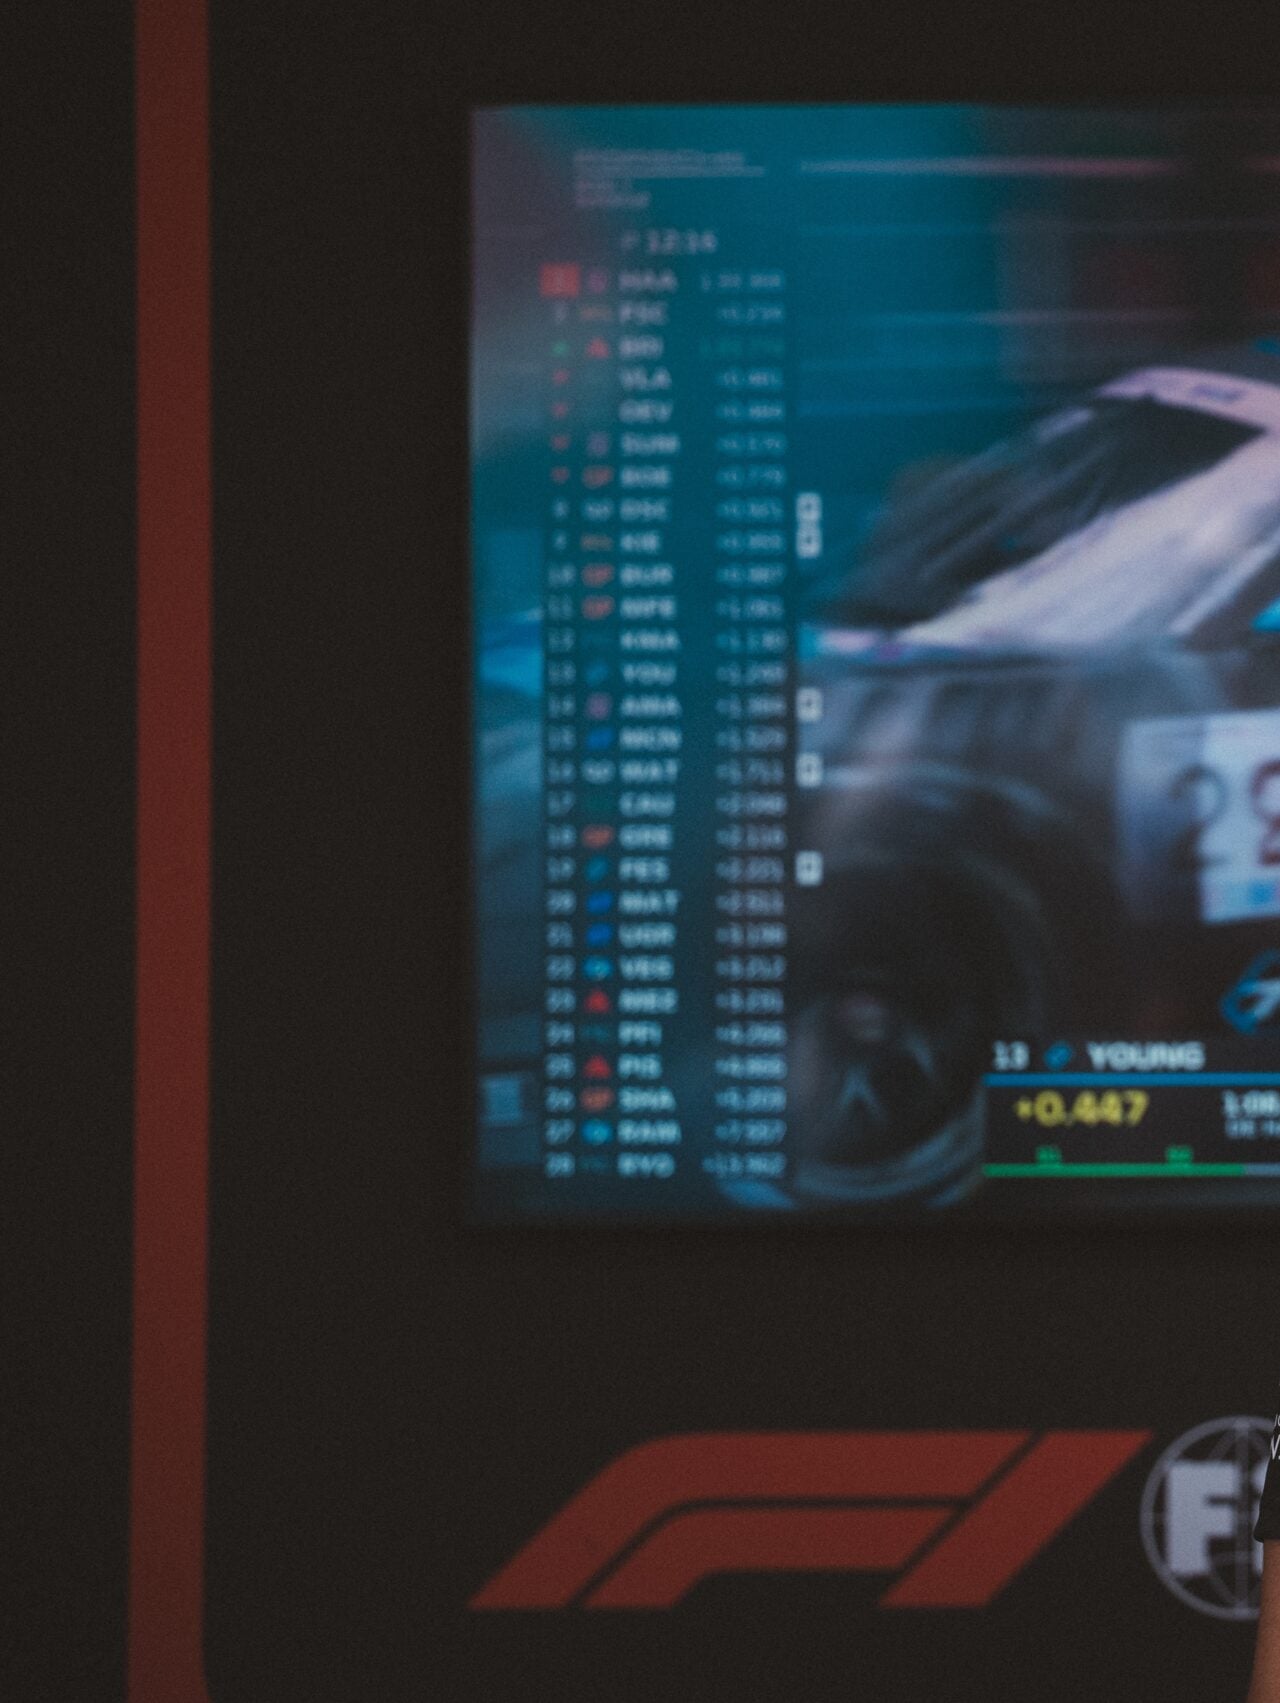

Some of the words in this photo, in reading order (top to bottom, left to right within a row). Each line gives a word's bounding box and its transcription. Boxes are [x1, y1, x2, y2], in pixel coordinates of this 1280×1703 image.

[994, 1041, 1029, 1070] 13
[1087, 1041, 1206, 1071] YOUNG
[1015, 1090, 1149, 1127] +0.447
